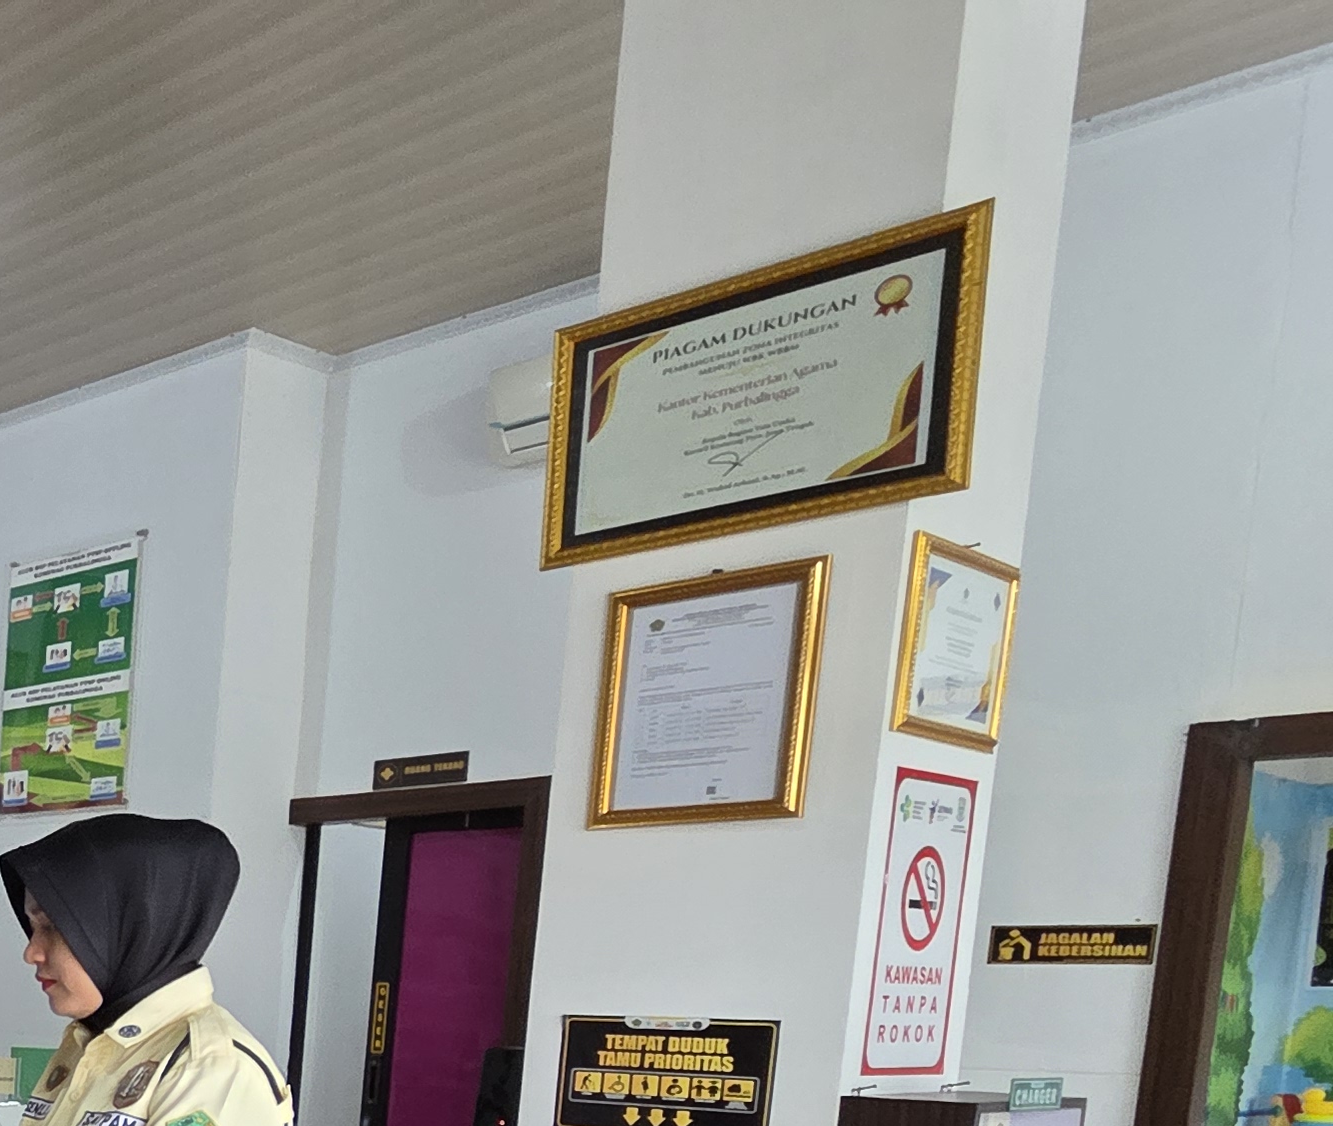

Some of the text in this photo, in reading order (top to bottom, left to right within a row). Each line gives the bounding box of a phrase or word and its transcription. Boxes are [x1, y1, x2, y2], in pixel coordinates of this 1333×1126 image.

[652, 294, 857, 364] PIAGAM DUKUNGAN
[1038, 932, 1115, 945] JAGALAH
[1037, 944, 1148, 957] KEBERSIHAN
[884, 964, 943, 986] KAWASAN
[882, 994, 938, 1015] TANPA
[605, 1034, 730, 1055] TEMPAT DUDUK
[876, 1024, 936, 1044] ROKOK
[597, 1050, 735, 1073] TAMU PRIORITAS
[1014, 1087, 1059, 1106] CHARGER
